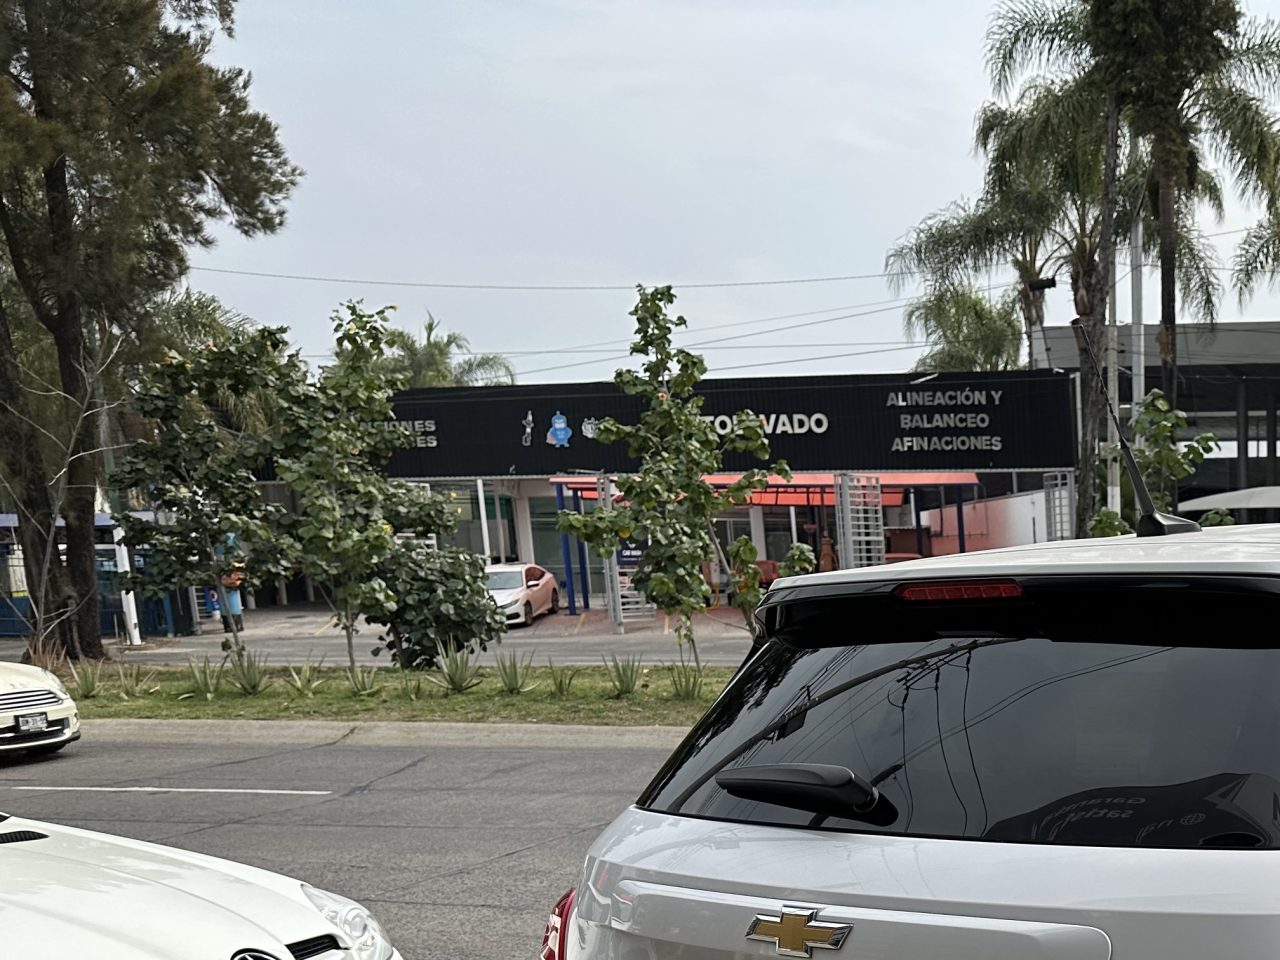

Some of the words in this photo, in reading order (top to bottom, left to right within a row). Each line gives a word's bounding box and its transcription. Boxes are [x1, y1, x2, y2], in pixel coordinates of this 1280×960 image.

[886, 387, 986, 406] ALINEACIÓN
[991, 390, 1003, 405] Y
[900, 414, 990, 428] BALANCEO
[891, 437, 1002, 451] AFINACIONES
